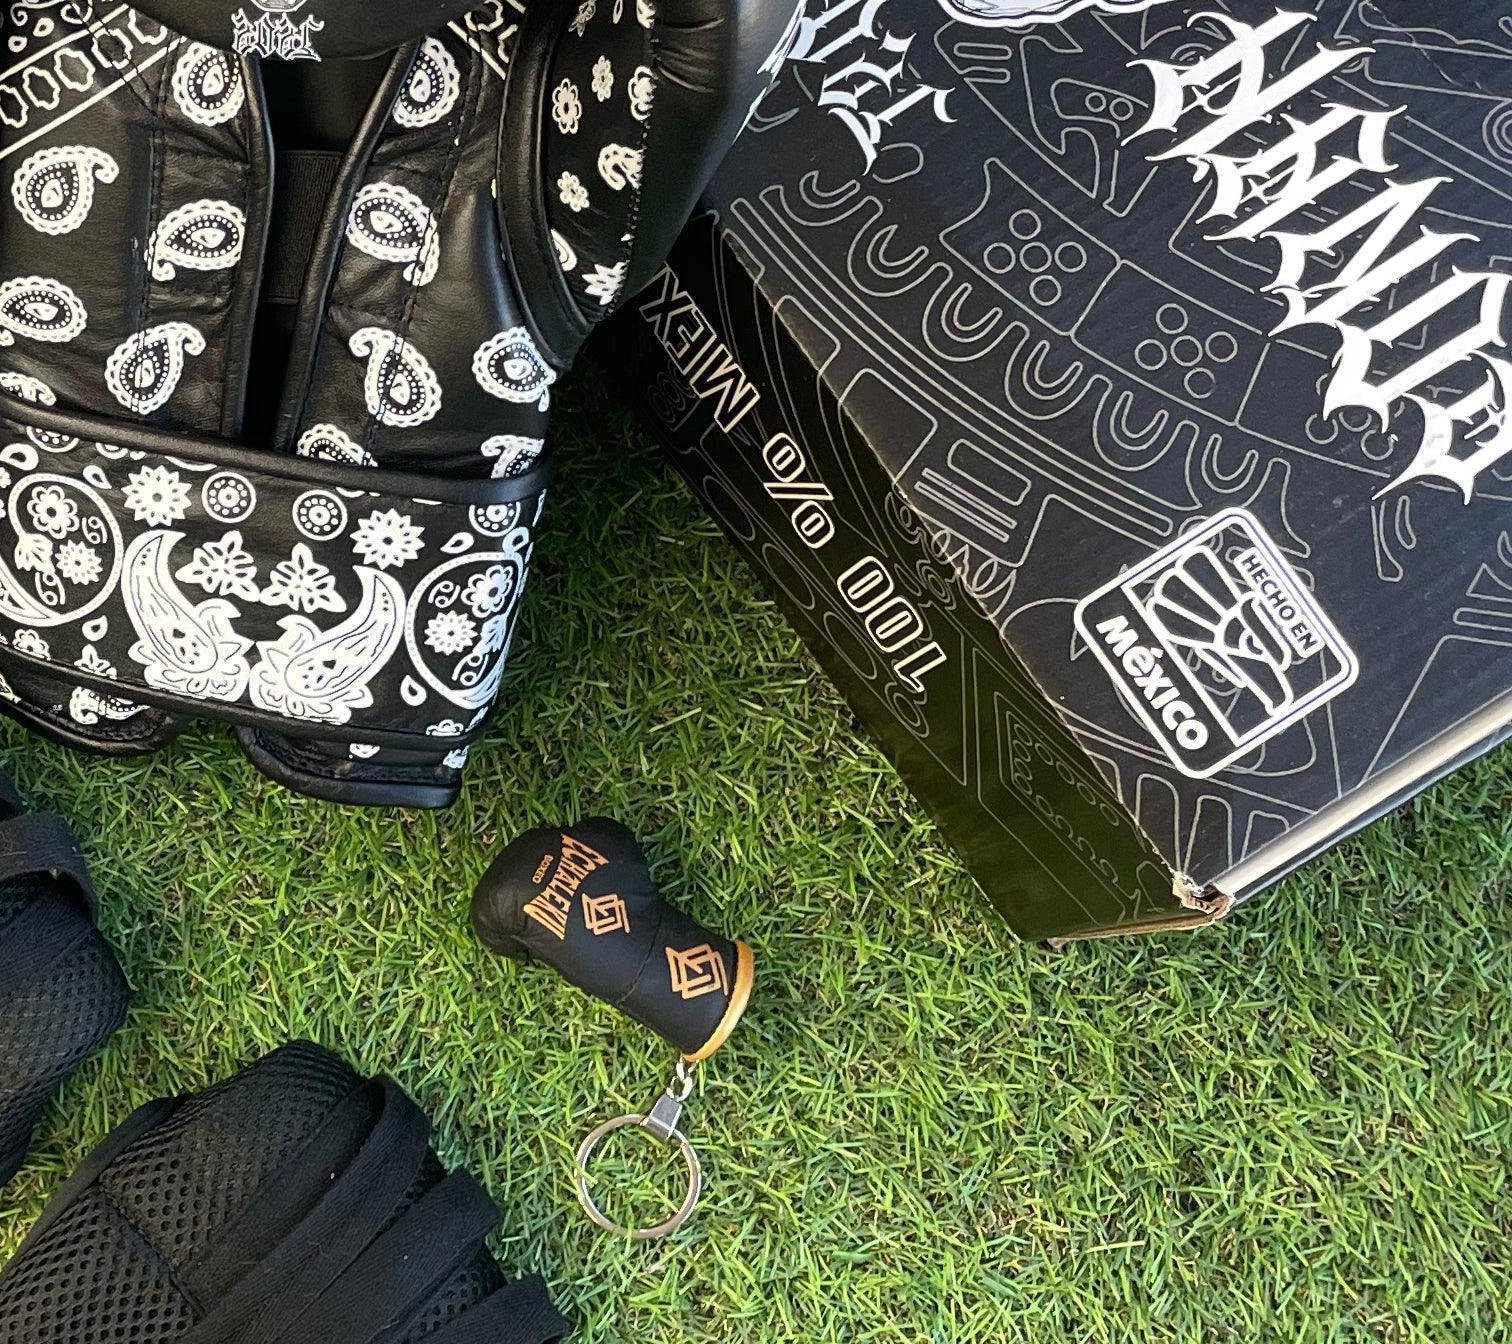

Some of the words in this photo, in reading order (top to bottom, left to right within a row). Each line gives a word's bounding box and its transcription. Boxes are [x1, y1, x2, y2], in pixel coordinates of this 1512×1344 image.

[639, 265, 760, 432] MEX
[837, 556, 947, 693] 100
[1241, 553, 1296, 622] HECHO
[1290, 617, 1320, 653] EN
